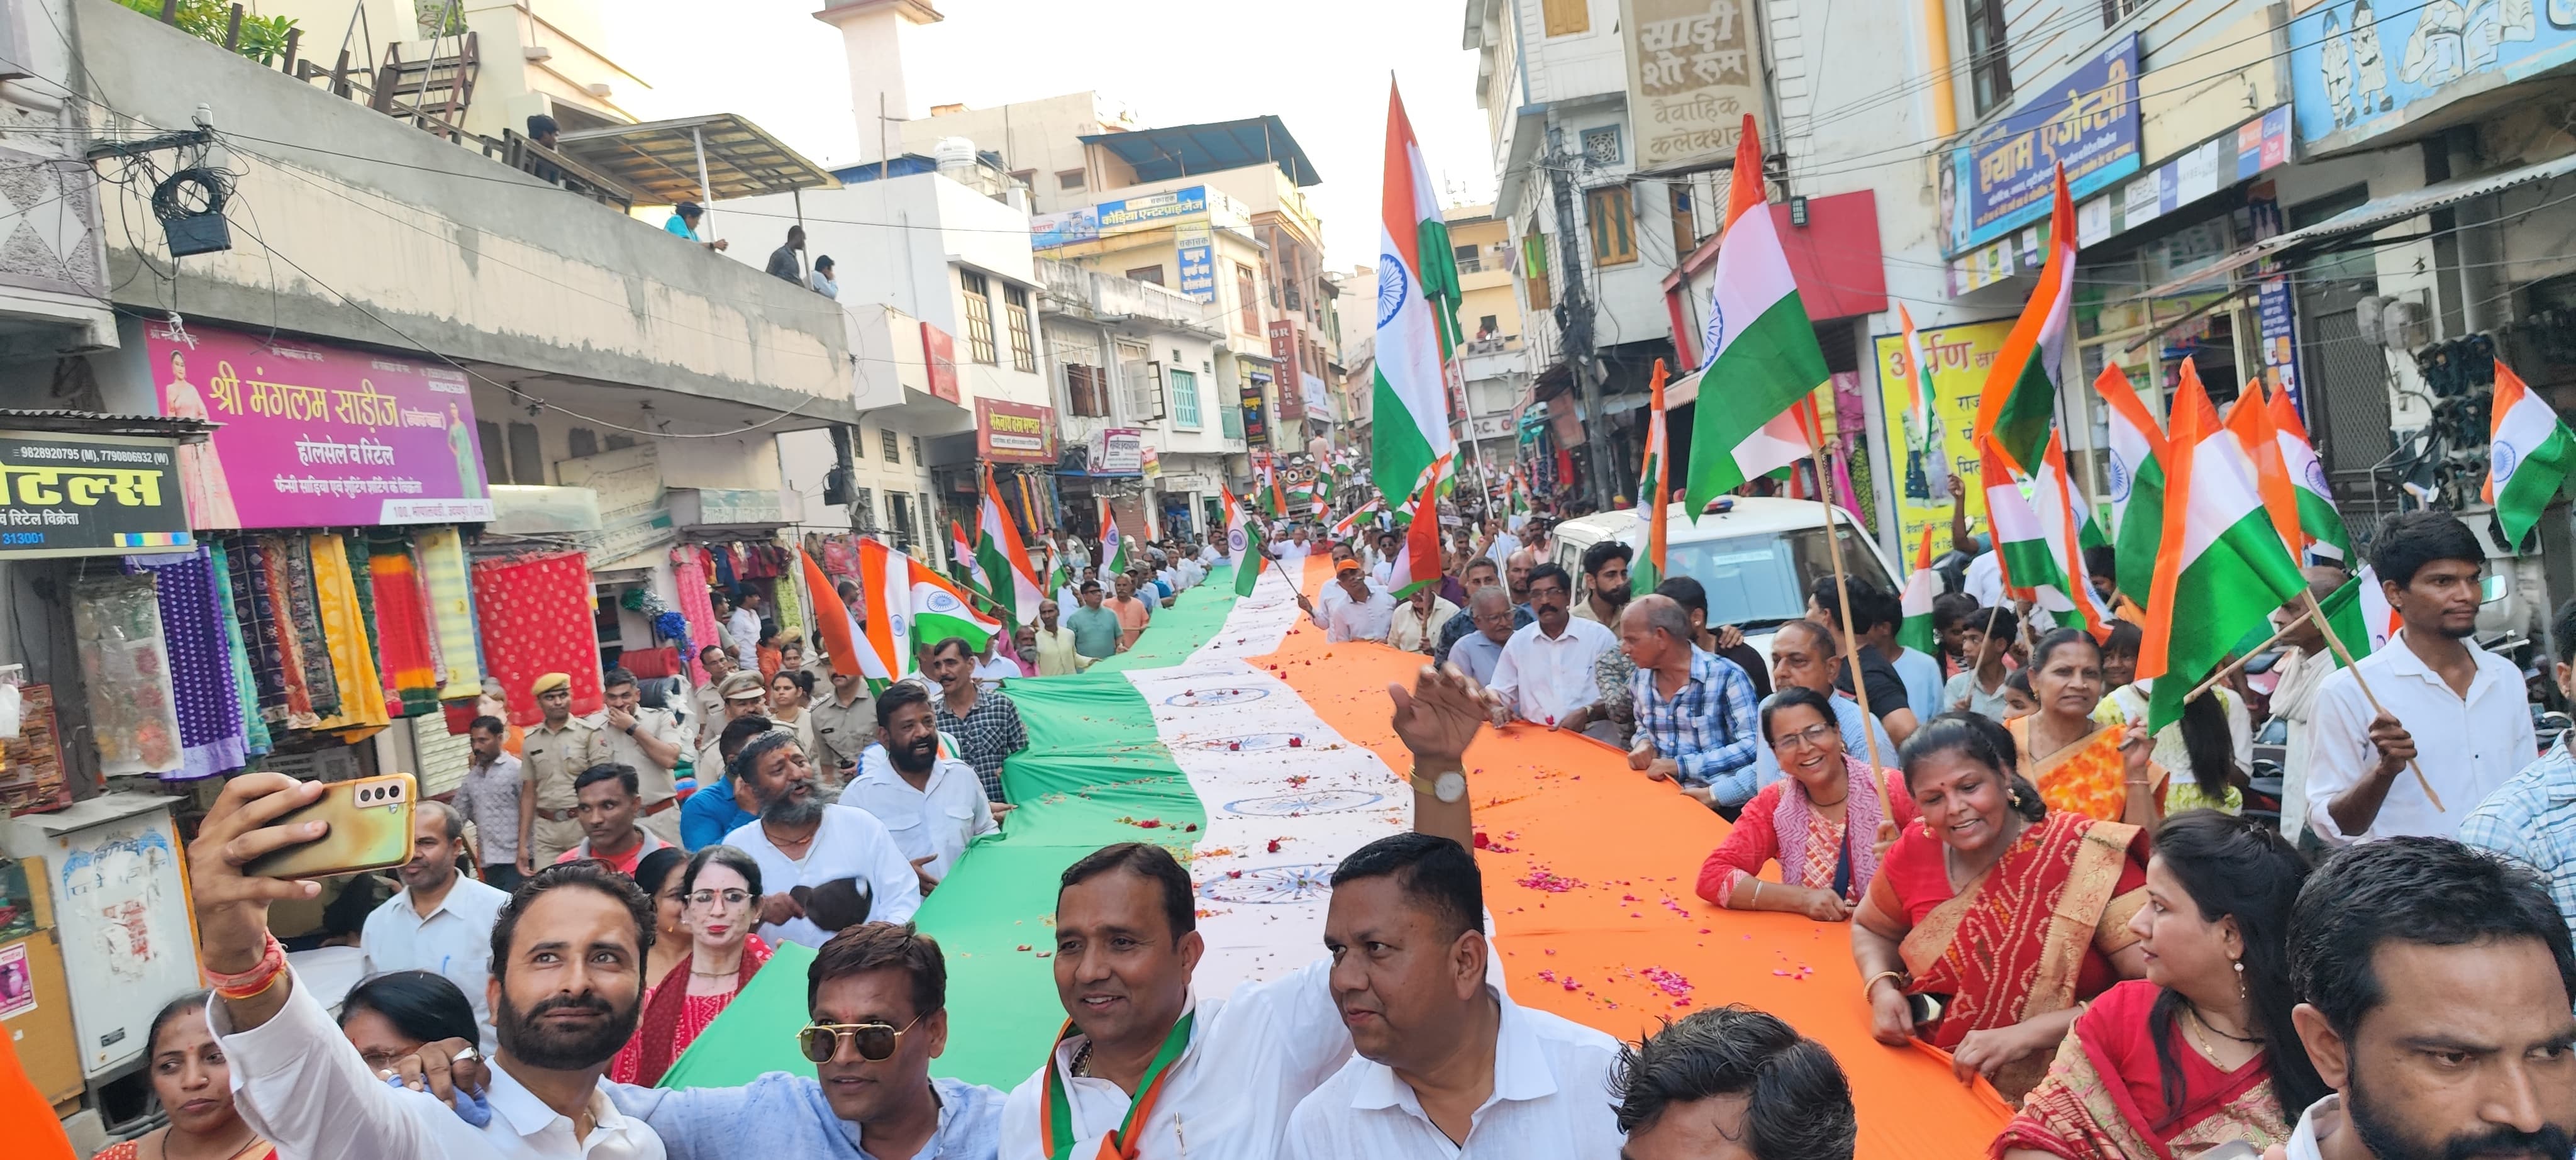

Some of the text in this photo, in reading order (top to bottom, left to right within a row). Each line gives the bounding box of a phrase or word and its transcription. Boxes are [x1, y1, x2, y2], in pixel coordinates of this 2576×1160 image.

[1641, 0, 1740, 53] साड़ी
[1643, 49, 1746, 89] शो रूम
[1650, 94, 1740, 123] वैवाहिक
[1979, 130, 2035, 196] श्याम
[2040, 58, 2129, 165] एजेन्सी
[1270, 327, 1290, 339] BR
[1278, 340, 1293, 407] JEWELLERS
[209, 360, 244, 416] श्री
[246, 366, 330, 422] मंगलम
[331, 378, 401, 433] साड़ीज
[20, 446, 169, 466] 9828920795 (M), 7790806932 (W)
[294, 433, 396, 466] होलसेल व रिटेल
[9, 508, 42, 526] रिटेल
[42, 508, 79, 525] विक्रेता
[3, 532, 45, 544] 313001
